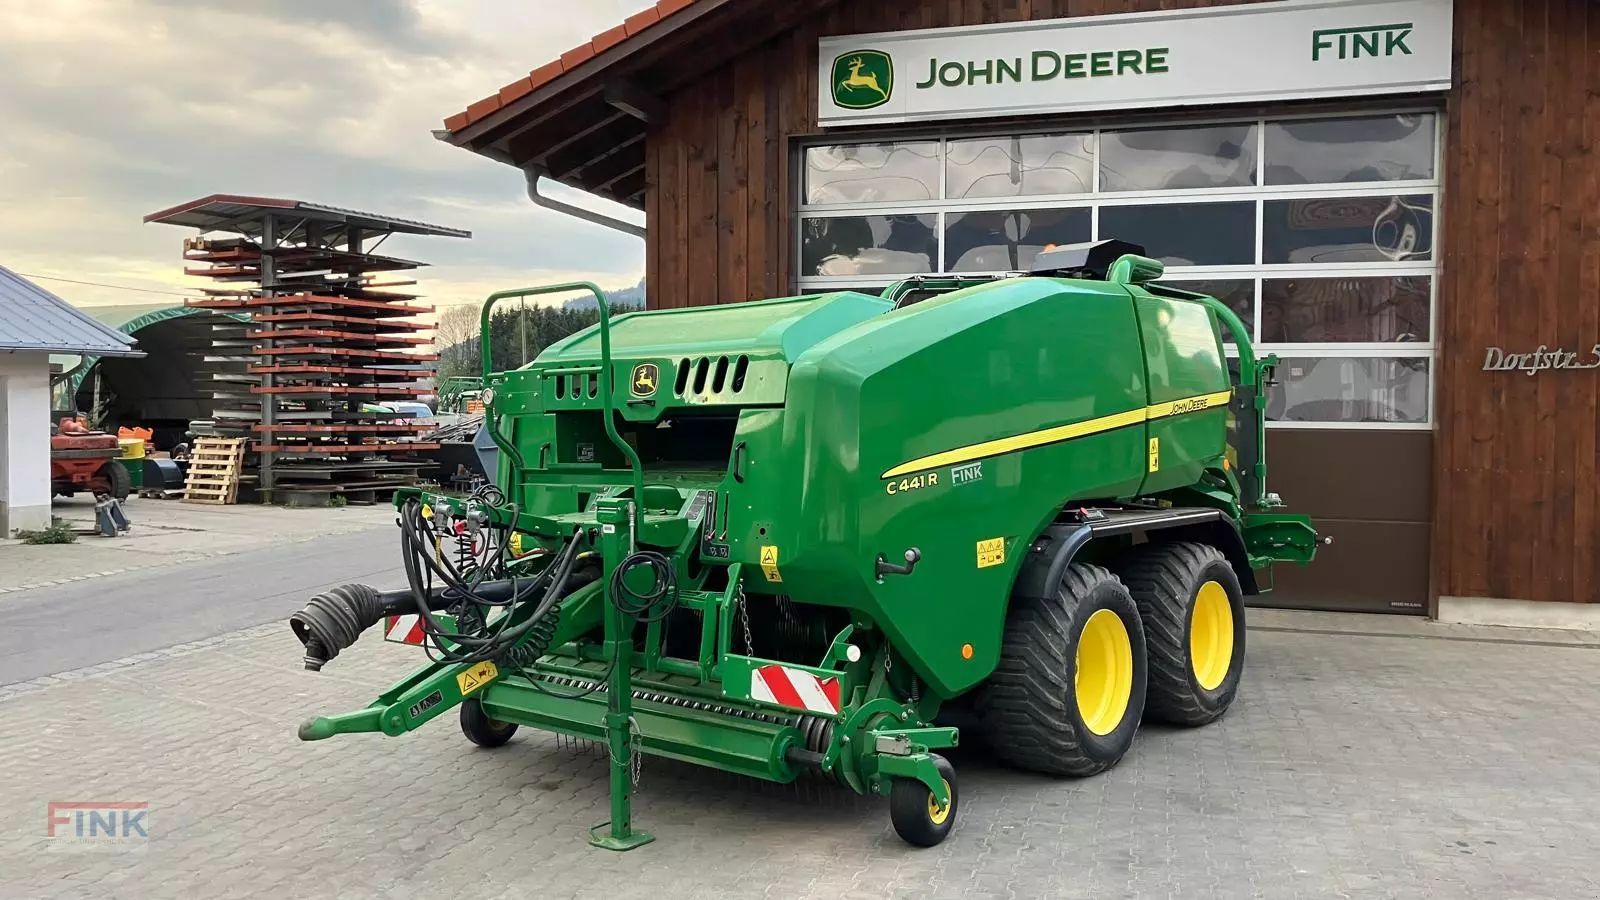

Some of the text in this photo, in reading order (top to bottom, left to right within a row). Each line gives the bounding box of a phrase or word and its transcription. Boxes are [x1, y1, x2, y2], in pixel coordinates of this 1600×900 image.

[1312, 23, 1413, 61] FINK
[916, 47, 1169, 89] JOHN DEERE
[1170, 398, 1209, 416] JOHN DEERE
[886, 481, 897, 495] C
[899, 474, 926, 492] 441
[928, 472, 938, 486] R
[951, 461, 983, 484] FINK
